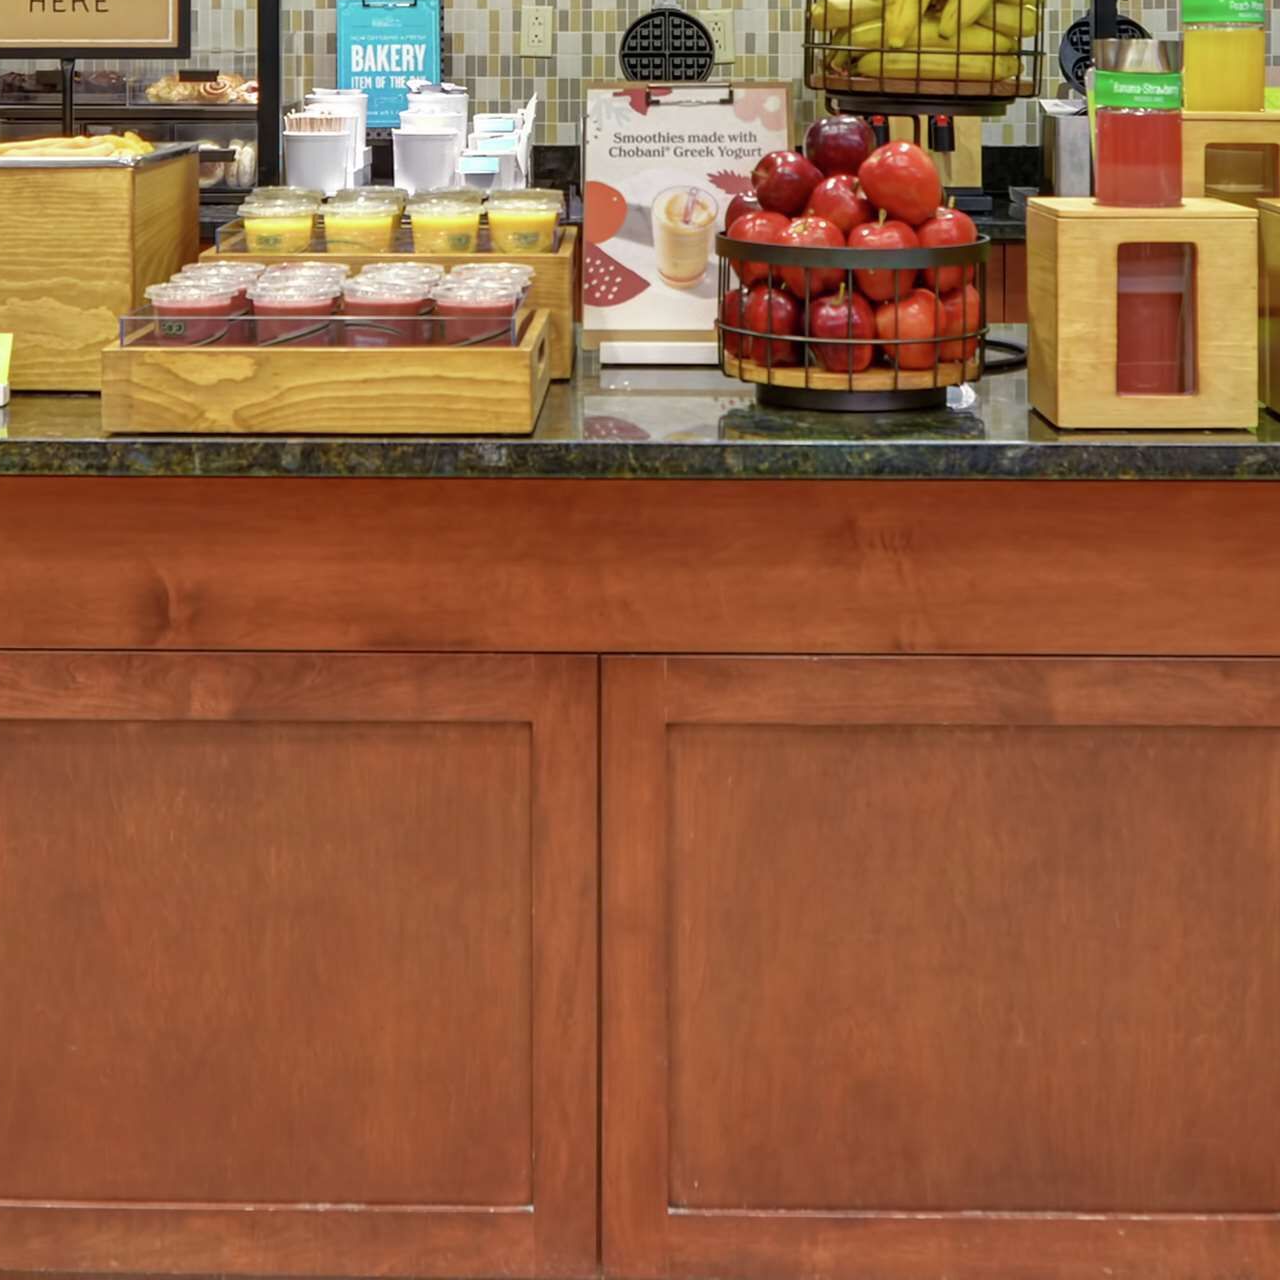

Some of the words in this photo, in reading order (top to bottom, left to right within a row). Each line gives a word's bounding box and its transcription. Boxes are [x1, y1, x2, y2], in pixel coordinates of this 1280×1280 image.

[351, 43, 427, 73] BAKERY
[351, 76, 372, 89] ITEM
[375, 76, 386, 89] OF
[390, 76, 407, 89] THE
[613, 131, 685, 144] Smoothies
[687, 131, 725, 144] made
[728, 131, 758, 144] with
[673, 146, 714, 158] Greek
[717, 146, 763, 160] Yogurt
